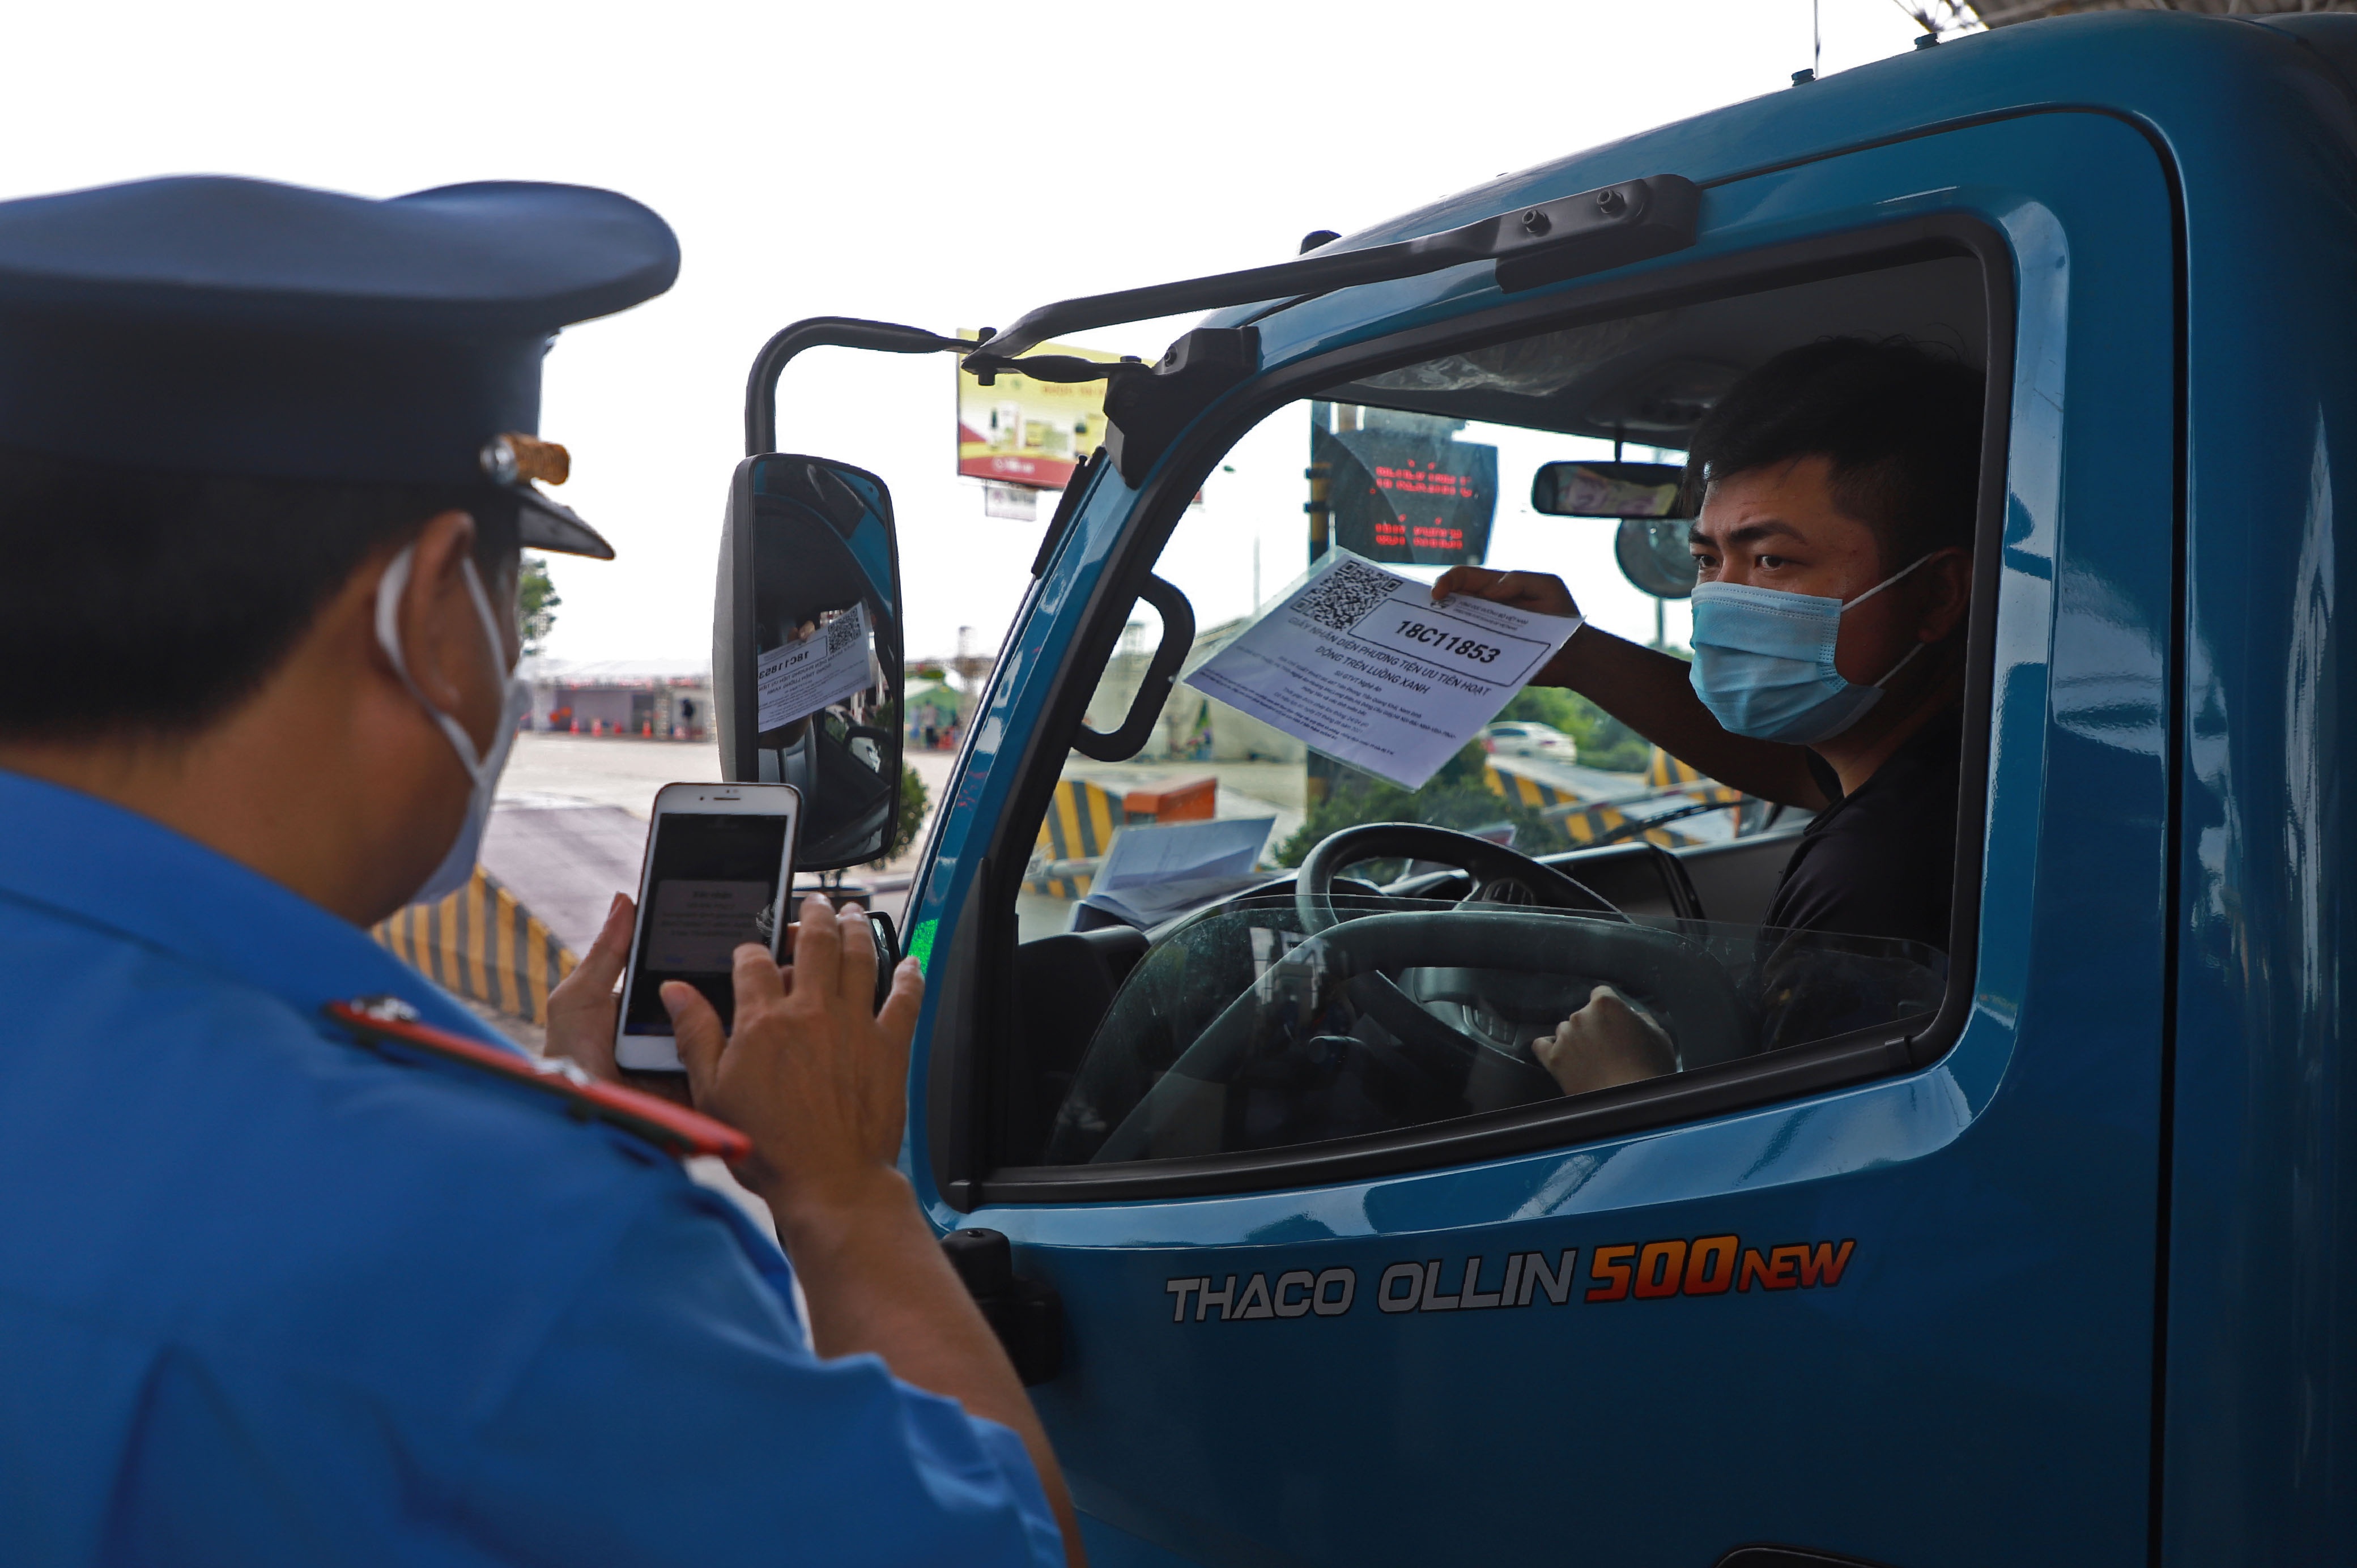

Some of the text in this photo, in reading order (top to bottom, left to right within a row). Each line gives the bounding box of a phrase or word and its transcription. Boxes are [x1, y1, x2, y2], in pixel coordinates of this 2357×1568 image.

[1309, 625, 1338, 643] NHẬN
[1337, 638, 1359, 651] DIỆN
[1358, 646, 1399, 665] PHƯƠNG
[1399, 659, 1422, 674] TIỆN
[1422, 668, 1439, 679] ƯU
[1437, 673, 1461, 687] TIÊN
[1460, 681, 1491, 696] HOẠT
[1395, 619, 1501, 664] 18C11853
[1314, 646, 1431, 694] ĐỘNG TRÊN LUỒNG XANH
[1342, 674, 1360, 683] GTVT
[1166, 1234, 1857, 1323] THACO OLLIN 500 NEW
